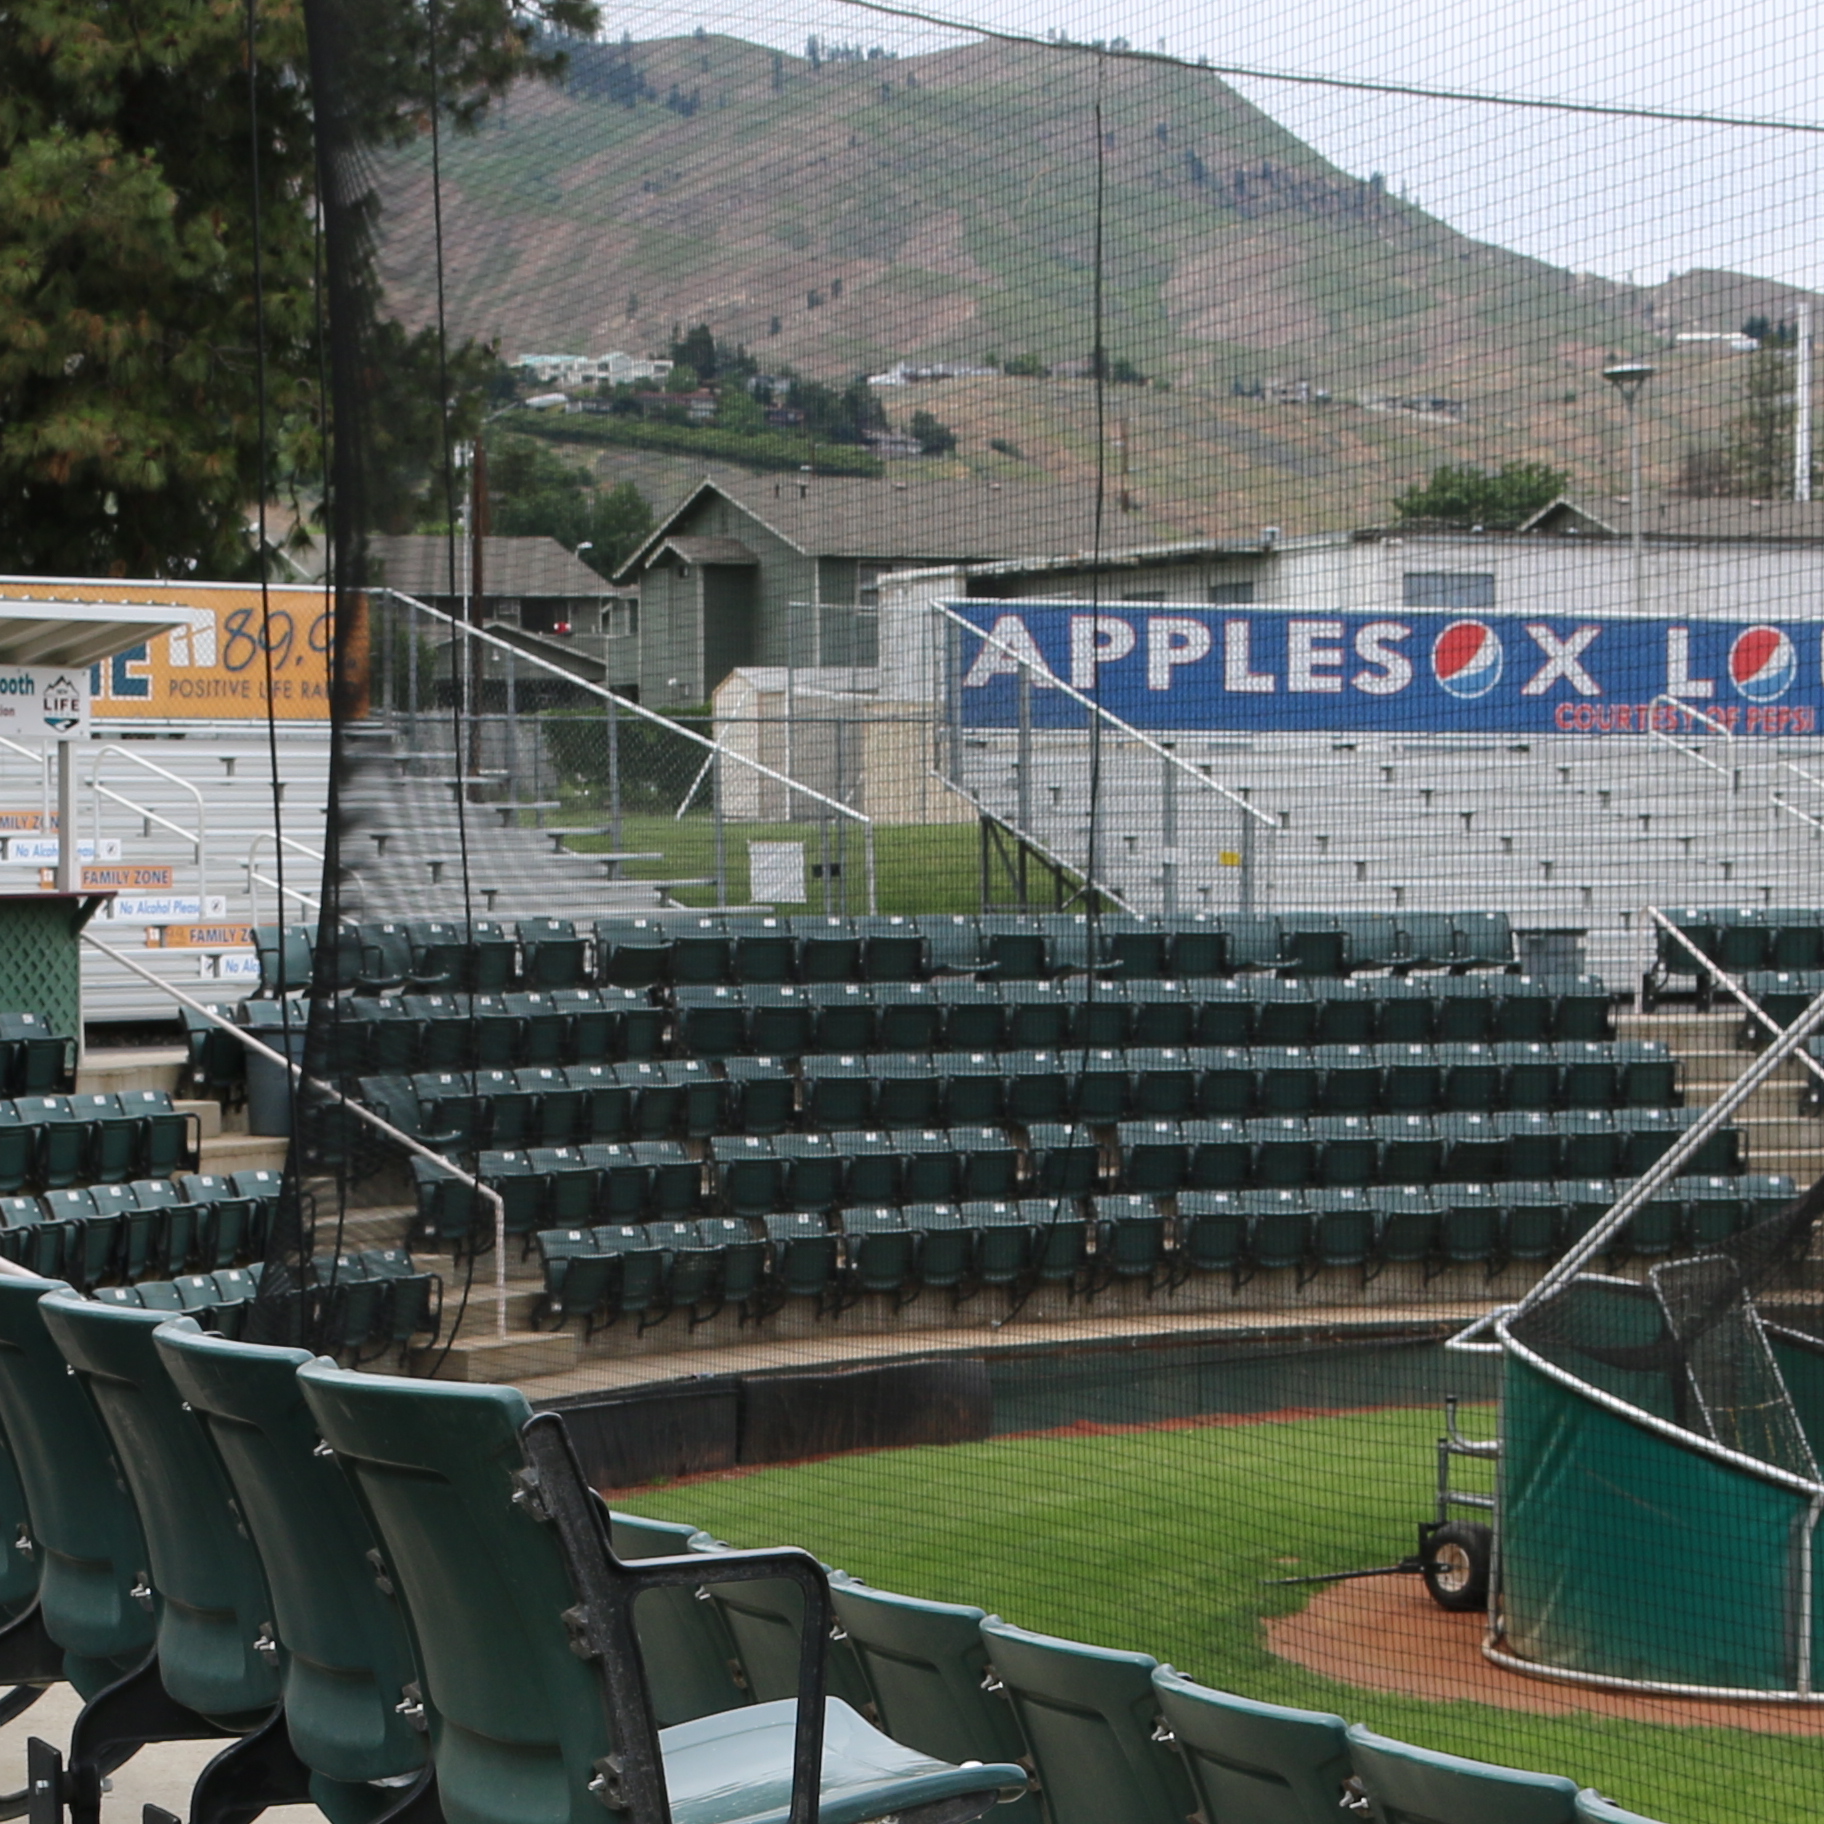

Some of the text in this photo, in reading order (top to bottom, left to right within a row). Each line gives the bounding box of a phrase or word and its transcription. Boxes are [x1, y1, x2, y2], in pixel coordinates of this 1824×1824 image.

[169, 678, 250, 699] POSITIVE
[44, 698, 80, 712] LIFE
[1554, 702, 1815, 733] COURTESY OF PEPSI
[15, 844, 29, 857] No
[83, 869, 169, 885] FAMILY ZONE
[119, 902, 133, 914] No
[137, 901, 170, 914] Alcohol
[189, 928, 236, 943] FAMILY
[225, 959, 239, 973] No
